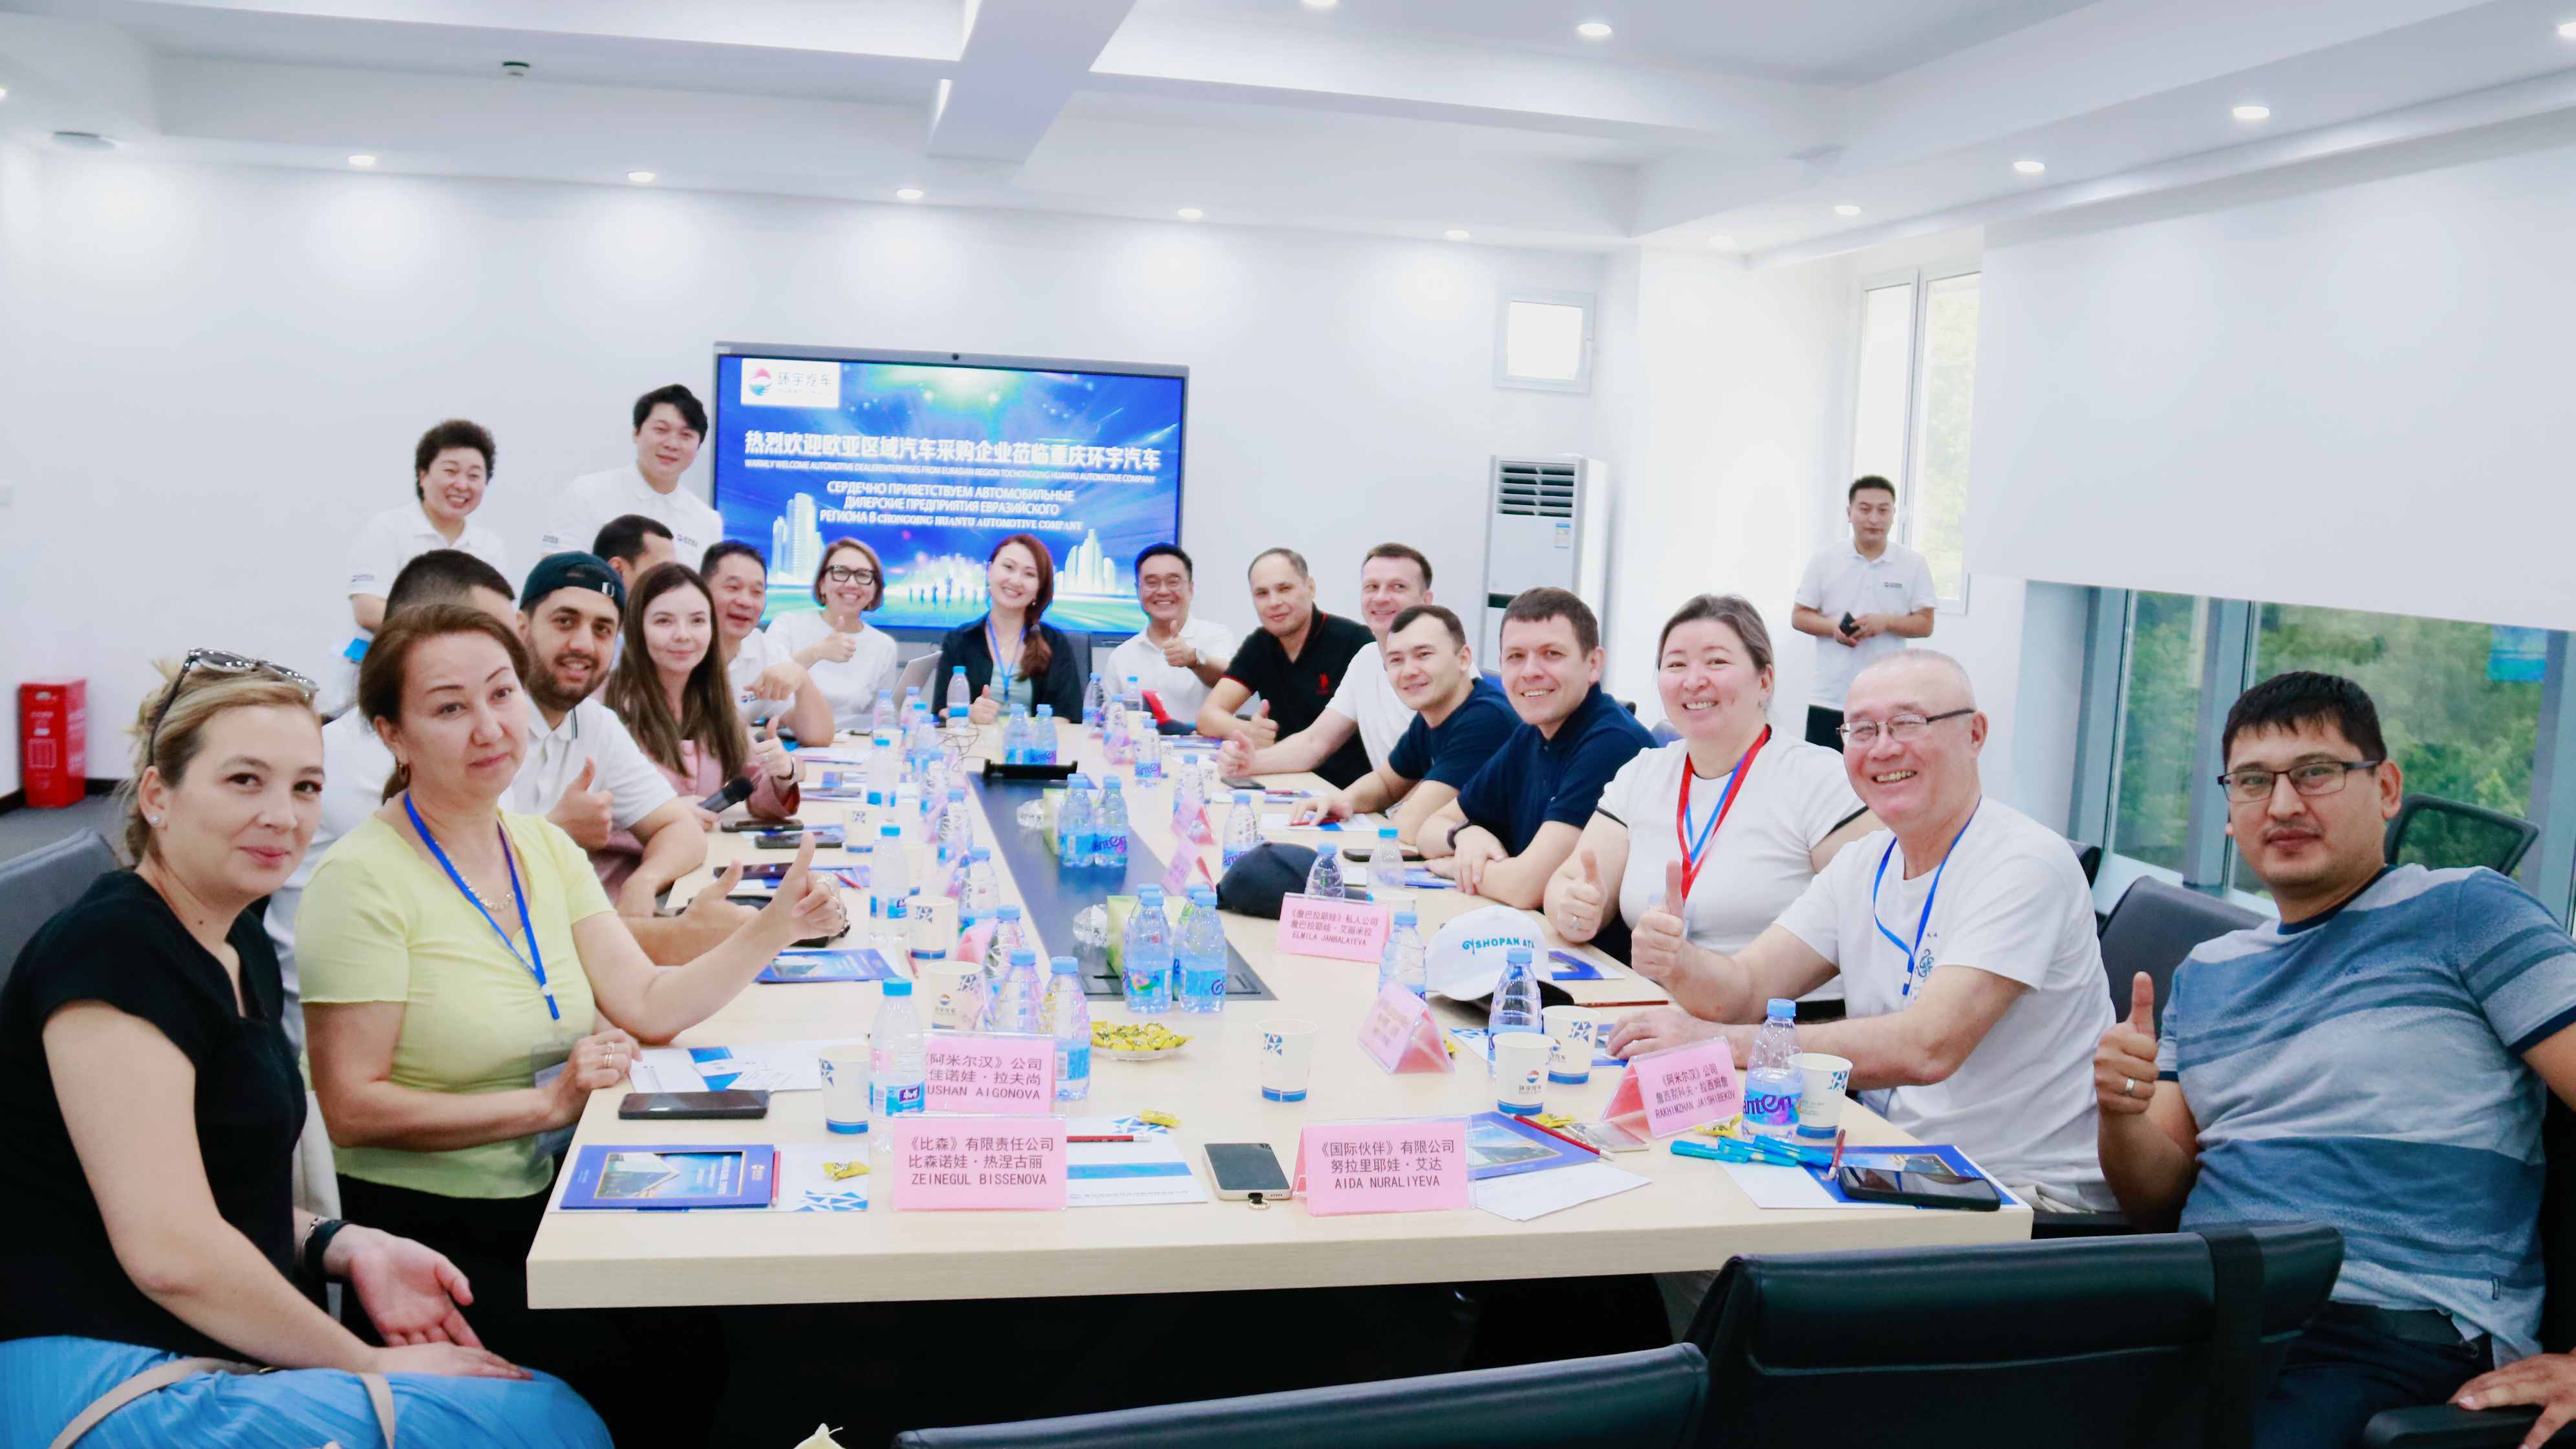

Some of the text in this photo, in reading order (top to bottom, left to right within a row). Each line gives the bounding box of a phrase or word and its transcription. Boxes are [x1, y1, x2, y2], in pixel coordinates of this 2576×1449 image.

[745, 430, 1161, 471] 热烈欢迎欧亚区域汽车采购企业莅临重庆环宇汽车
[827, 480, 1075, 502] СЕРДЕЧНО ПРИВЕТСТВУЕМ АВТОМОБИЛЬНЫЕ
[843, 496, 1060, 516] ДИЛЕРСКИЕ ПРЕДПРИЯТИЯ ЕВРАЗИЙСКОГО
[820, 509, 867, 523] РЕГИОНА
[935, 515, 975, 527] HUANYU
[977, 518, 1038, 530] AUTOMOTIVE
[1038, 520, 1083, 531] COMPANY
[1293, 930, 1317, 941] ELMILA
[1476, 937, 1519, 949] SHOPAN
[925, 1069, 1041, 1086] 佳诺娃·拉夫尚
[976, 1088, 1040, 1099] AIGONOVA
[1655, 1101, 1694, 1119] RAKHIMZHAN
[911, 1174, 1047, 1185] ZEINEGUL BISSENOVA
[1335, 1175, 1441, 1189] AIDA NURALIYEVA
